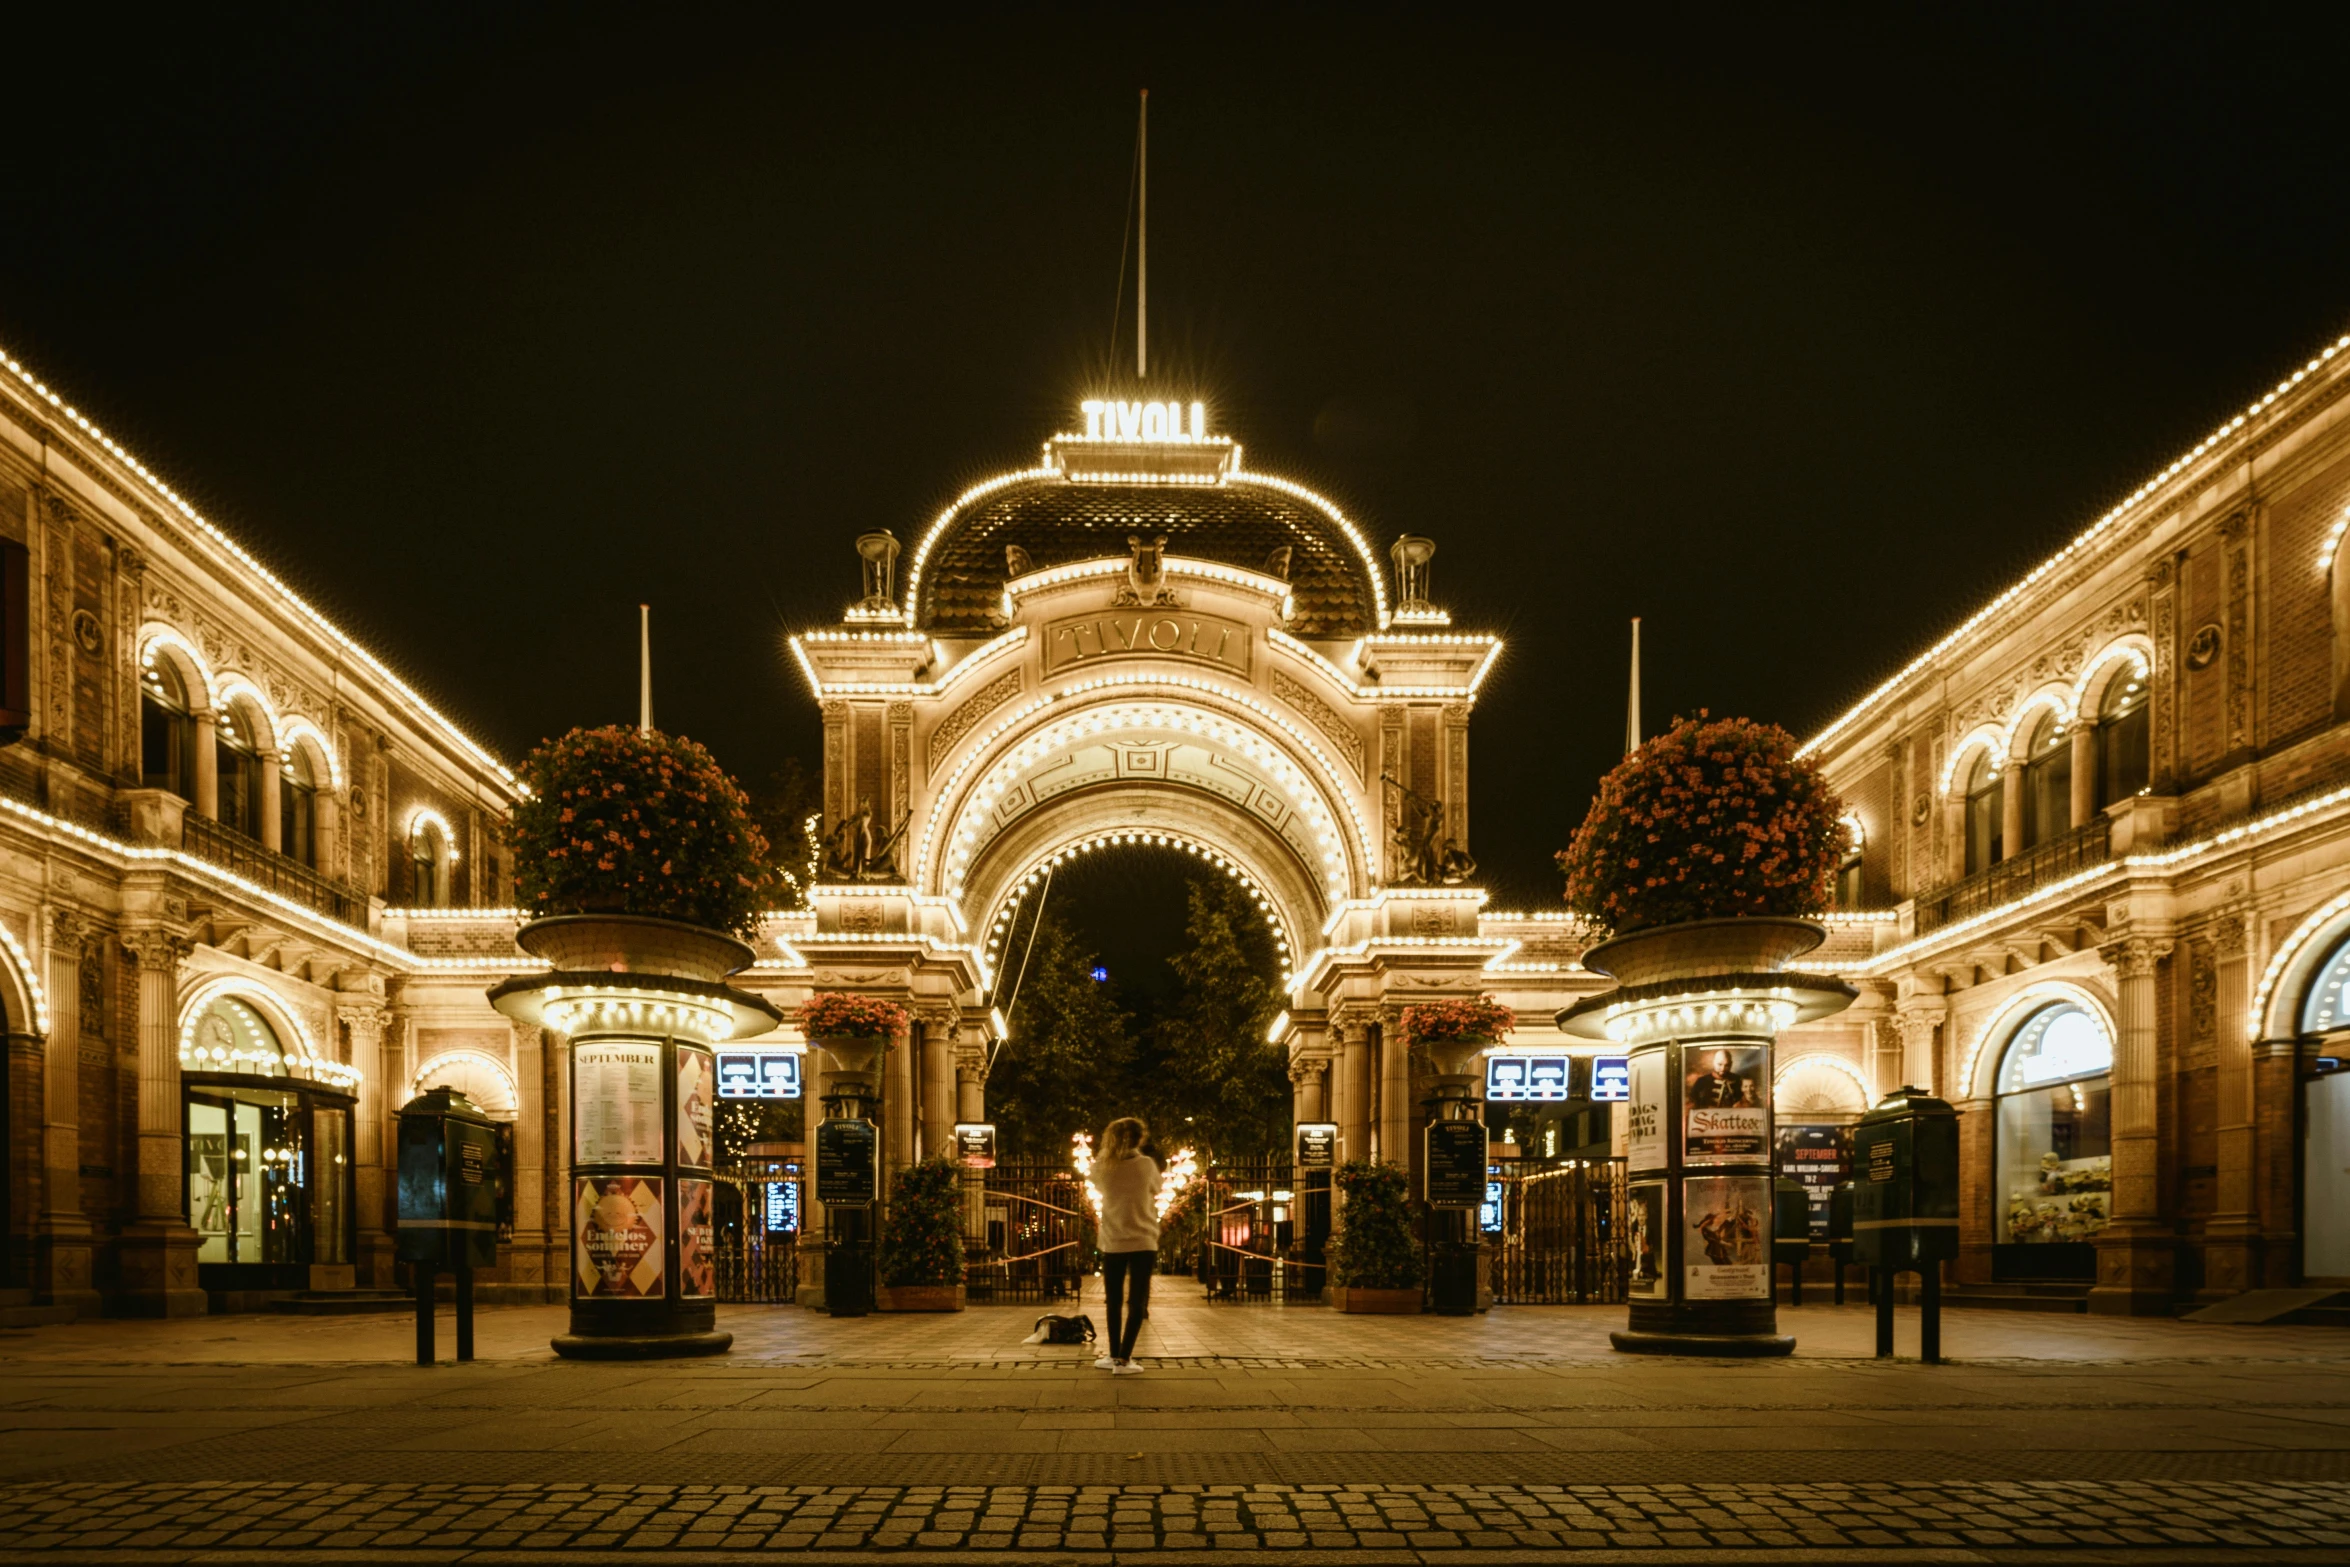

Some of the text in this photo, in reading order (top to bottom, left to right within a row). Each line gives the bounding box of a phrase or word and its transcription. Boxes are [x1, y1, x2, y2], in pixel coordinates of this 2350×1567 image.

[1081, 401, 1204, 442] TIVOLI
[1059, 618, 1231, 660] TIVOLI
[579, 1054, 655, 1065] SEPTEMBER
[1795, 1148, 1837, 1160] SEPTEMBER
[587, 1229, 647, 1241] Endelos
[586, 1242, 649, 1251] sommer
